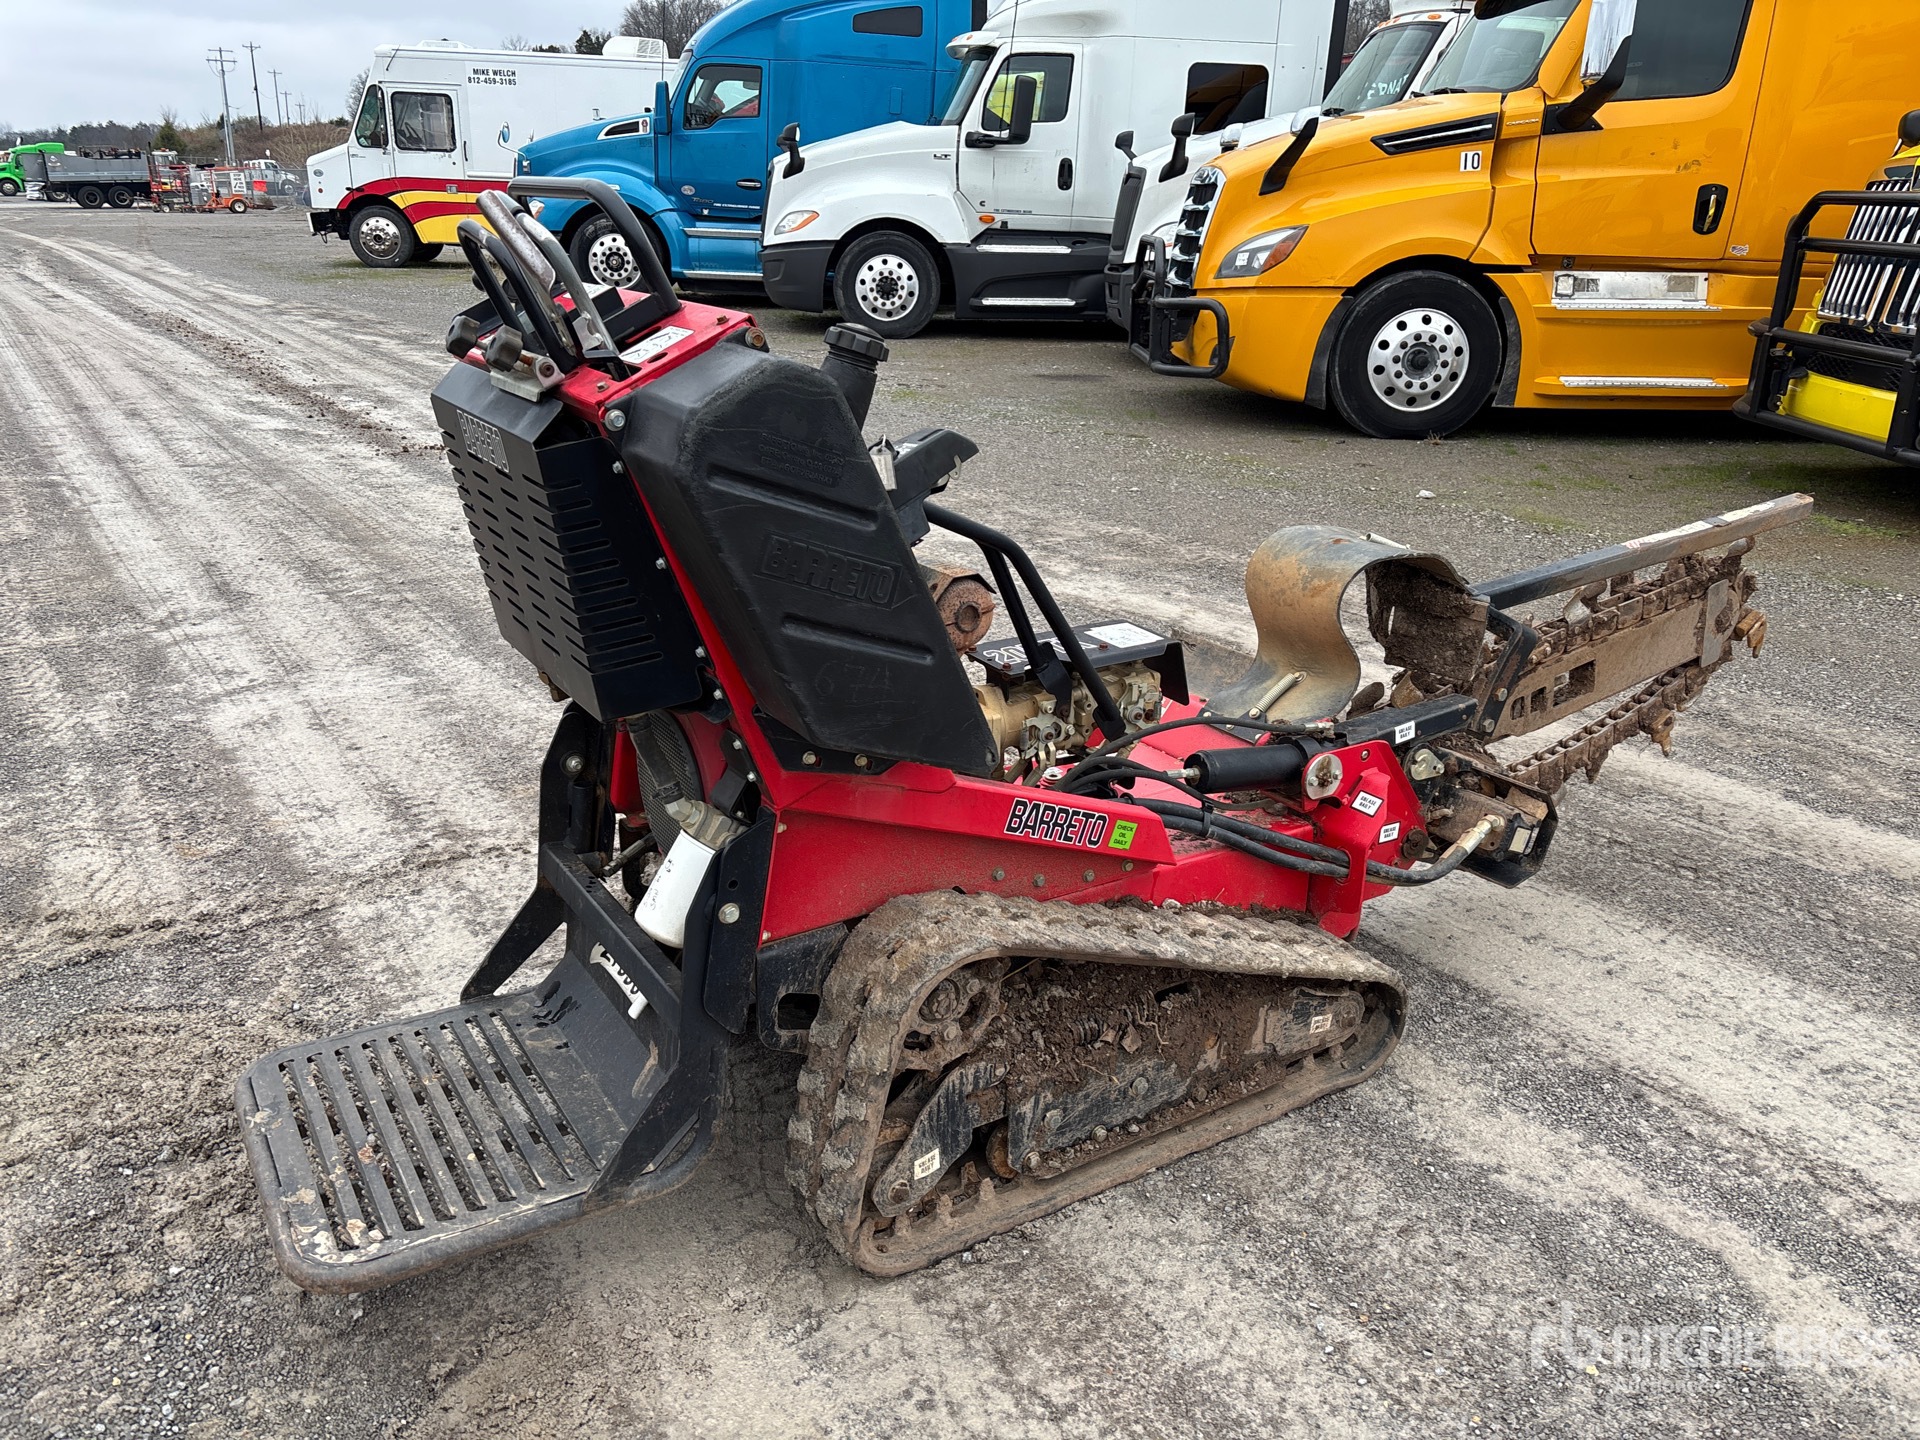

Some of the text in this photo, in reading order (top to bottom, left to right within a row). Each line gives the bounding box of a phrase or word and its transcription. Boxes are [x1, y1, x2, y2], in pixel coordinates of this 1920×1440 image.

[472, 68, 516, 77] MIKE WELCH
[467, 76, 516, 85] 812-459-3185
[1463, 152, 1481, 170] 10
[761, 534, 895, 605] BARRETO
[1004, 797, 1109, 849] BARRETO
[1116, 823, 1135, 833] CHECK
[1118, 831, 1127, 839] OIL
[1113, 838, 1128, 846] DAILY
